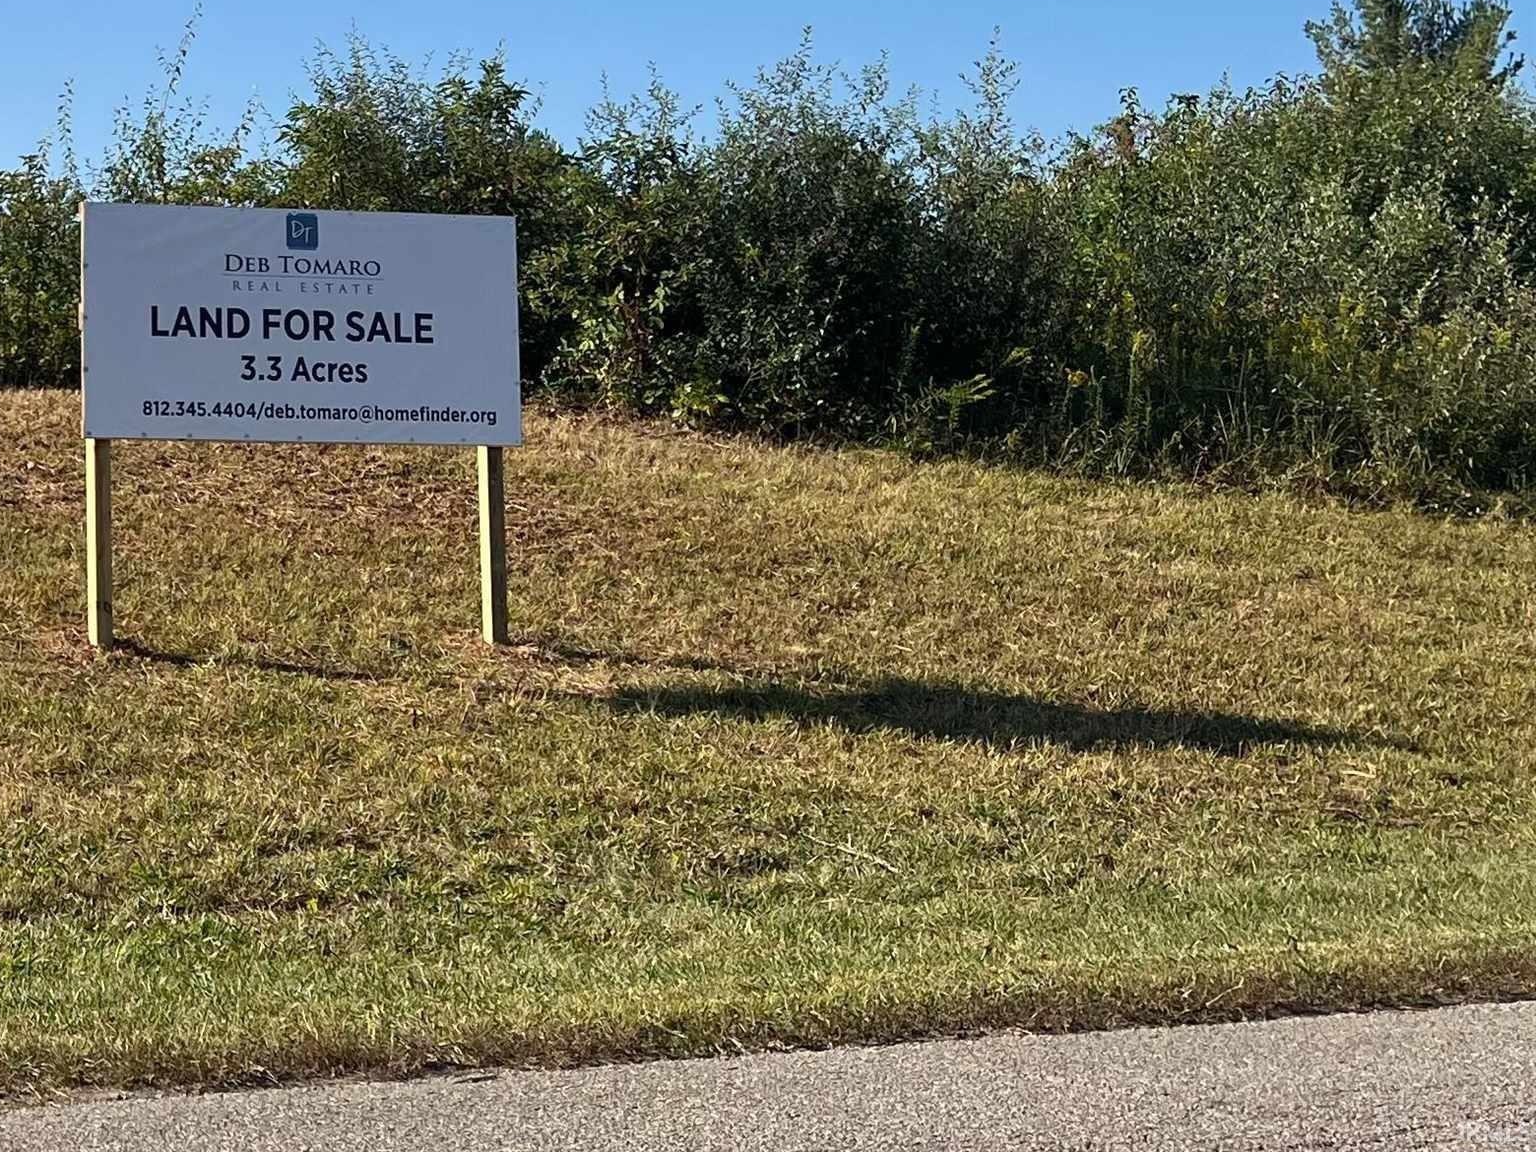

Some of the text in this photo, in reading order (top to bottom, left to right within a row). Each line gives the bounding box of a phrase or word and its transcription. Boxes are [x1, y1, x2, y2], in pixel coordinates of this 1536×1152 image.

[232, 280, 375, 296] REAL ESTATE
[150, 305, 434, 344] LAND FOR SALE
[240, 355, 368, 384] 3.3 Acres
[142, 400, 497, 426] 812.345.4404/deb.tomaro@homefinder.org
